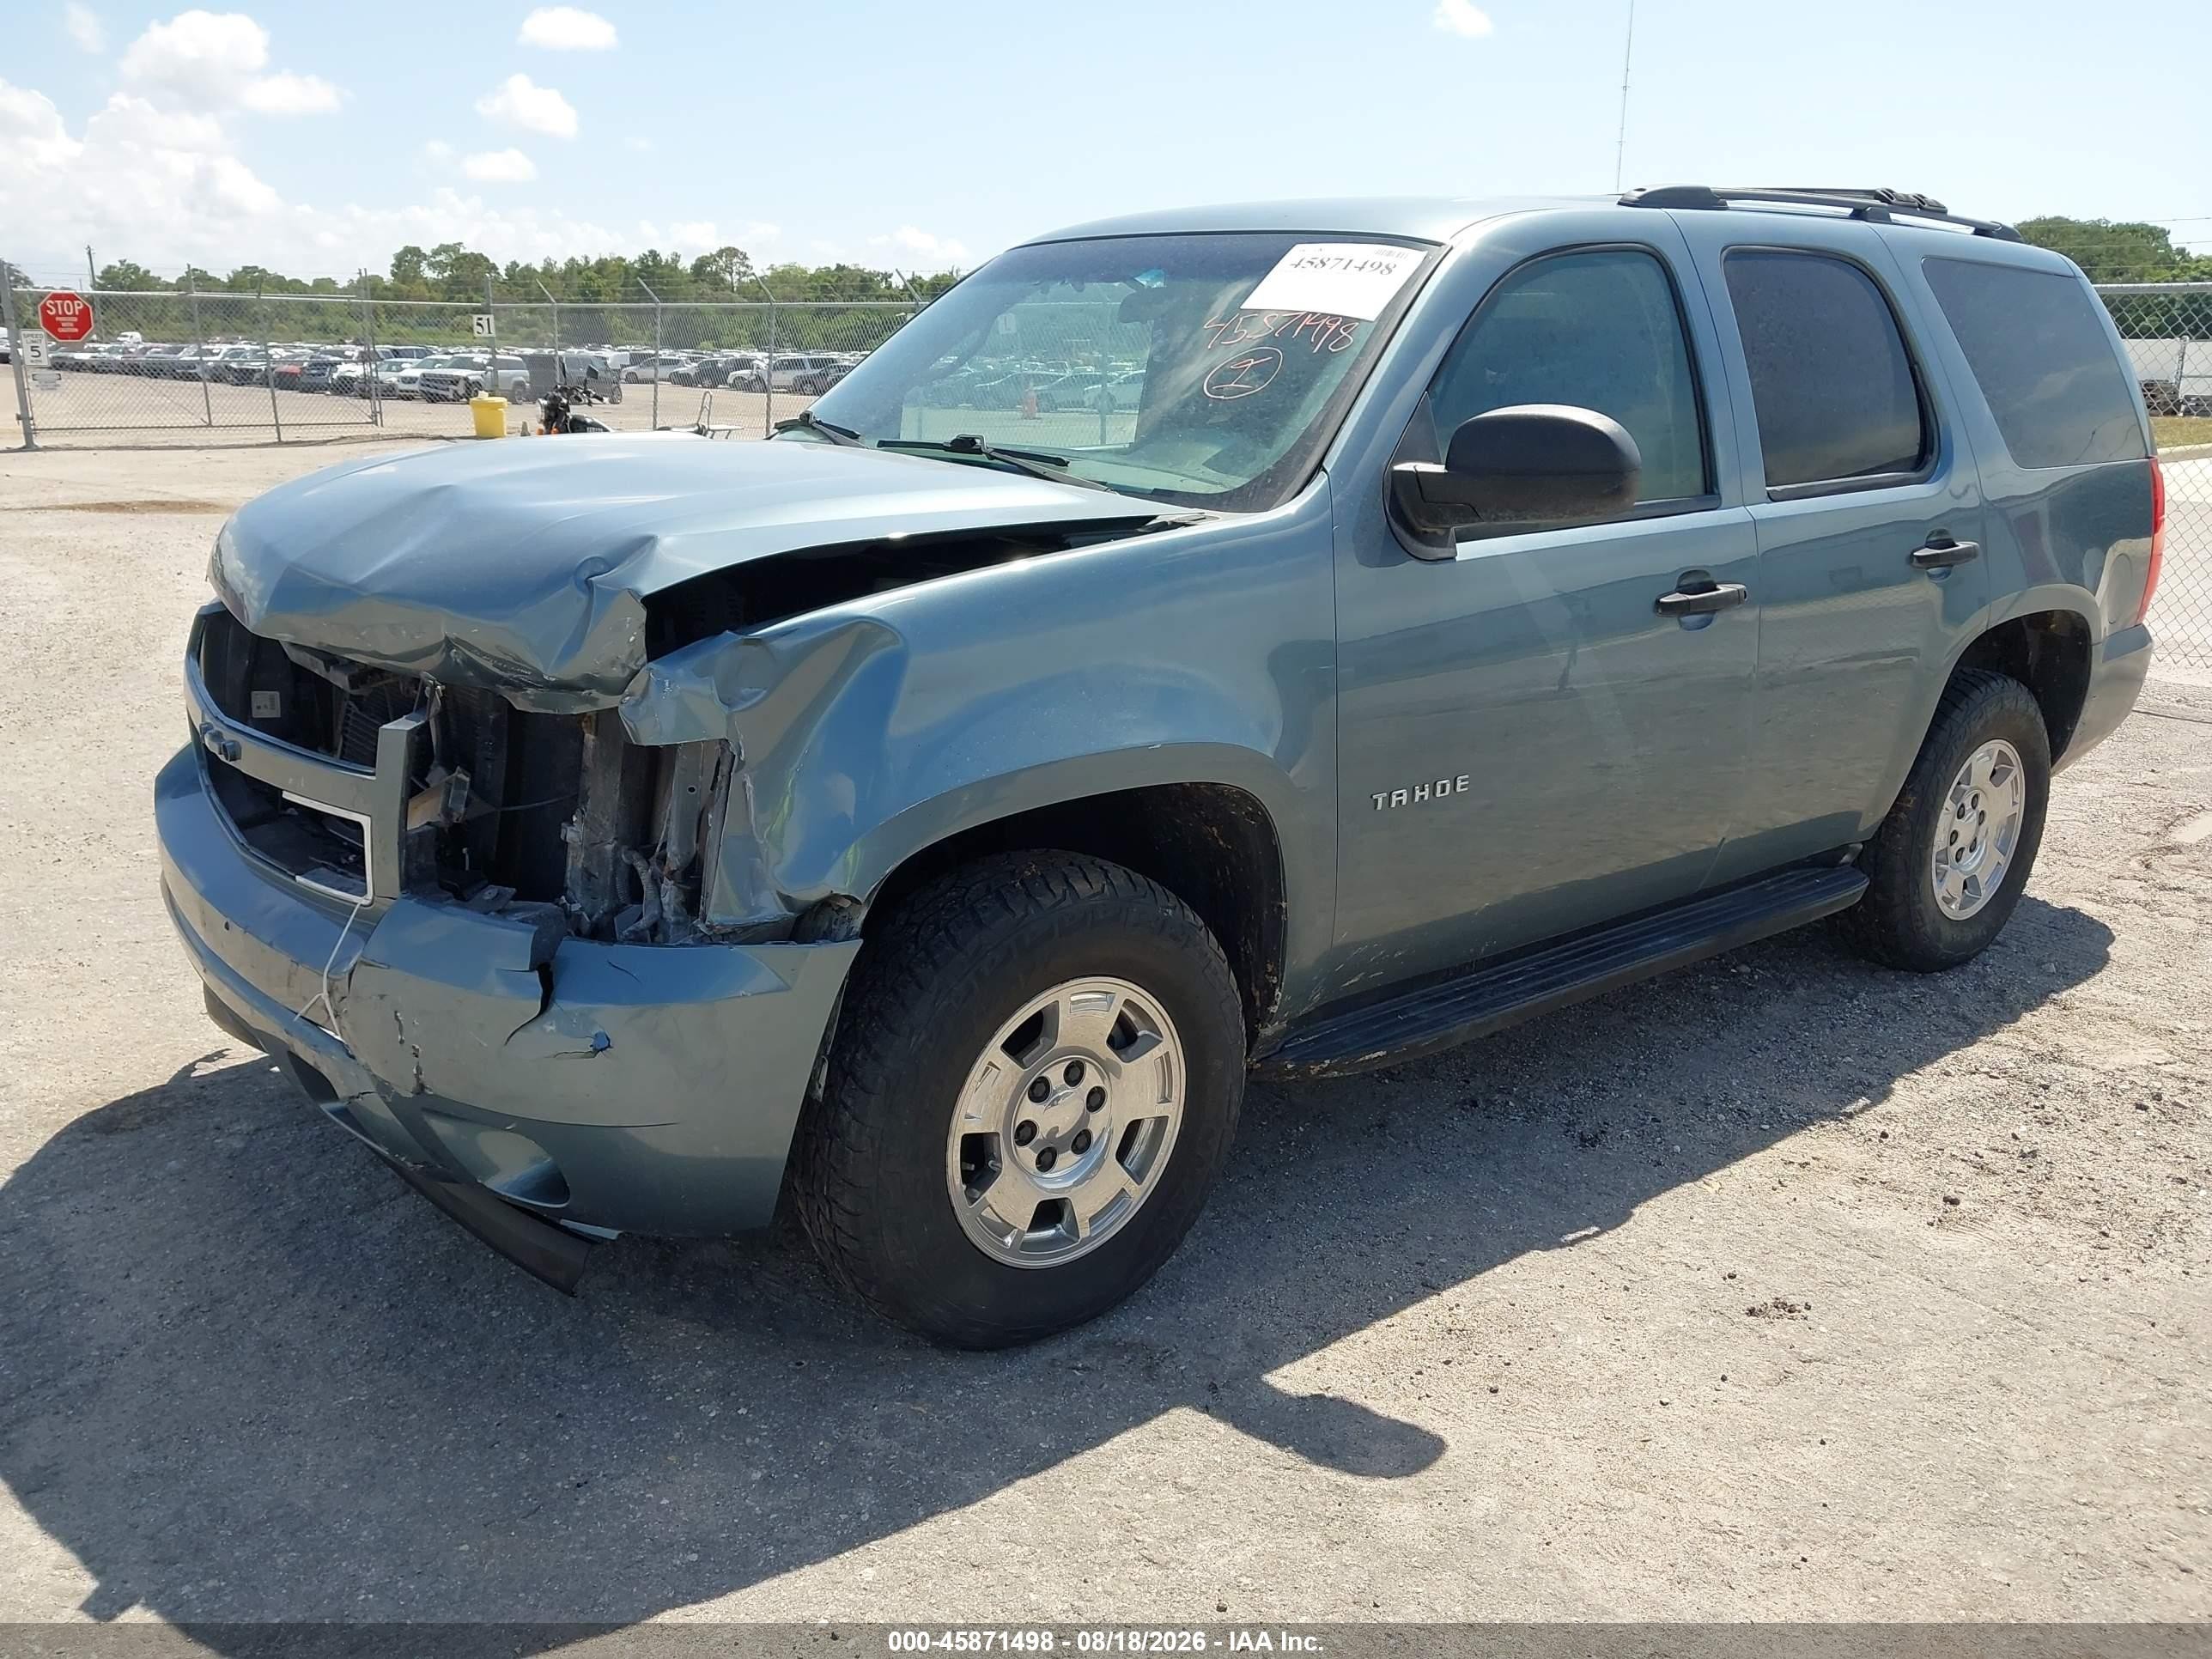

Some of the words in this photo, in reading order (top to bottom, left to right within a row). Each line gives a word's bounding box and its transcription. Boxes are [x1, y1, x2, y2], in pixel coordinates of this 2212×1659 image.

[1290, 257, 1397, 276] 45871498
[46, 300, 83, 315] STOP
[476, 317, 492, 335] 51
[30, 345, 42, 358] 5
[1371, 774, 1470, 811] TAHOE
